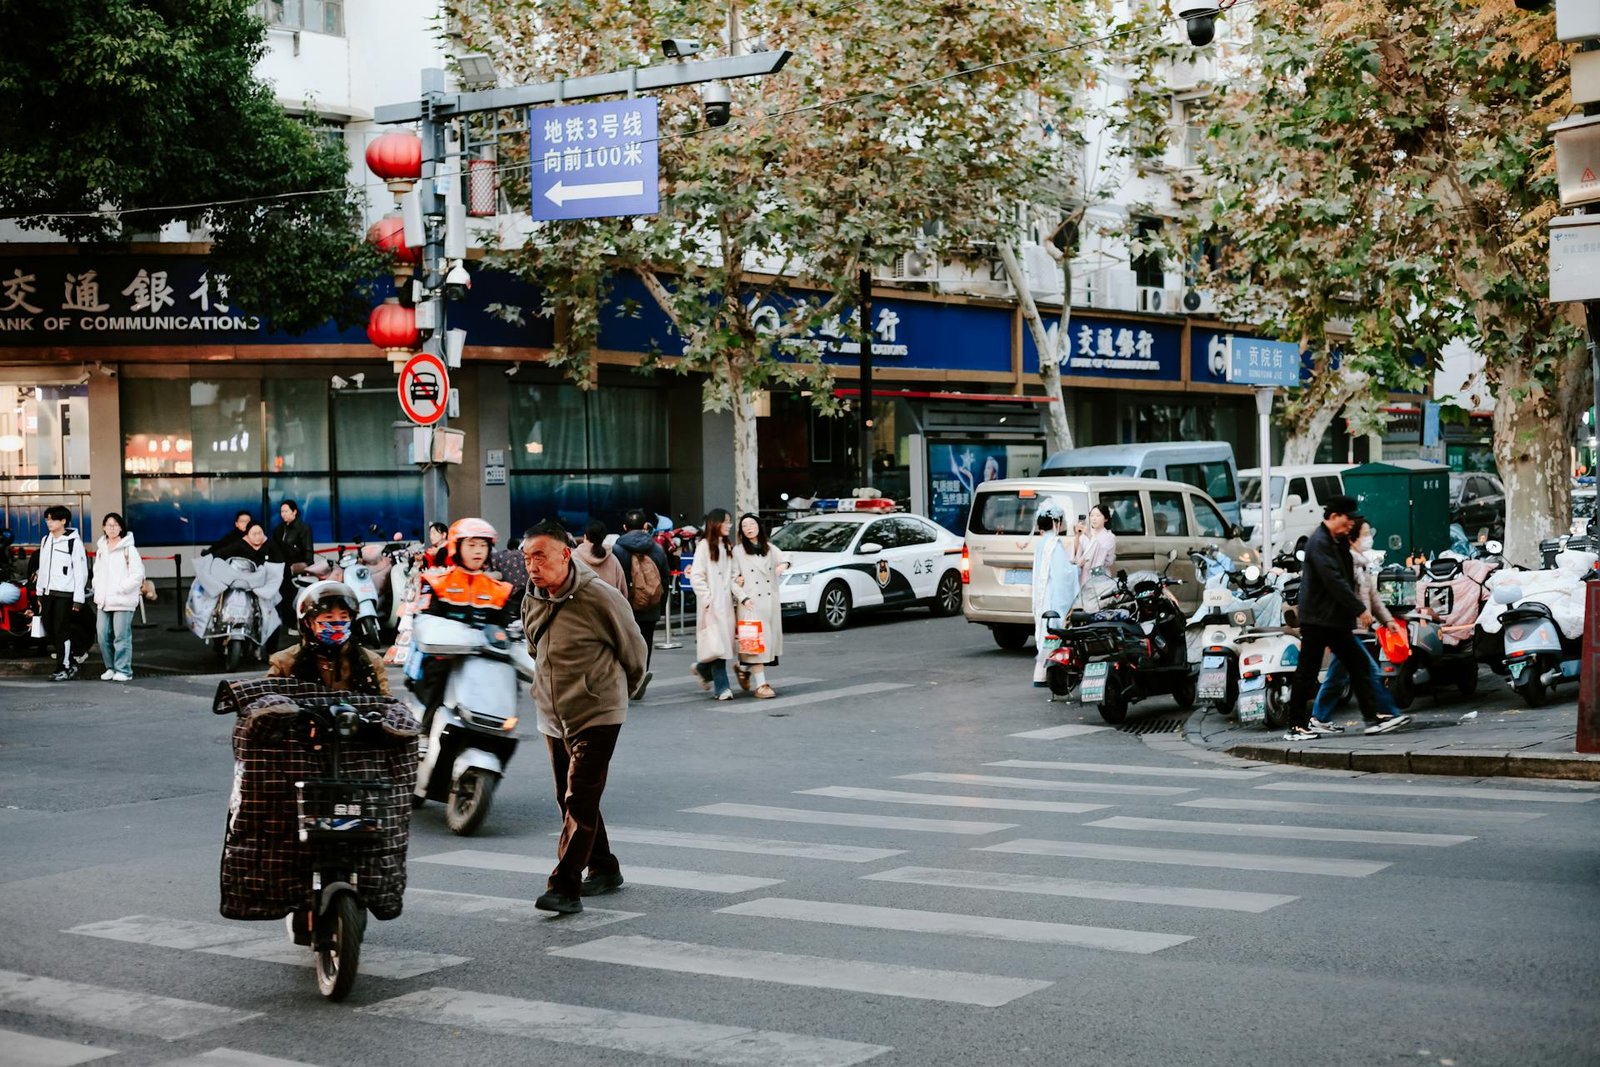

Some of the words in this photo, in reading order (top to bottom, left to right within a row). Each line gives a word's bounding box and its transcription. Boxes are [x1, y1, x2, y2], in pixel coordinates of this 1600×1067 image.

[543, 111, 643, 145] 地铁3号线
[543, 141, 643, 173] 向前100米
[43, 316, 72, 331] OF
[1248, 346, 1283, 368] 贡院街
[913, 559, 933, 574] 公安
